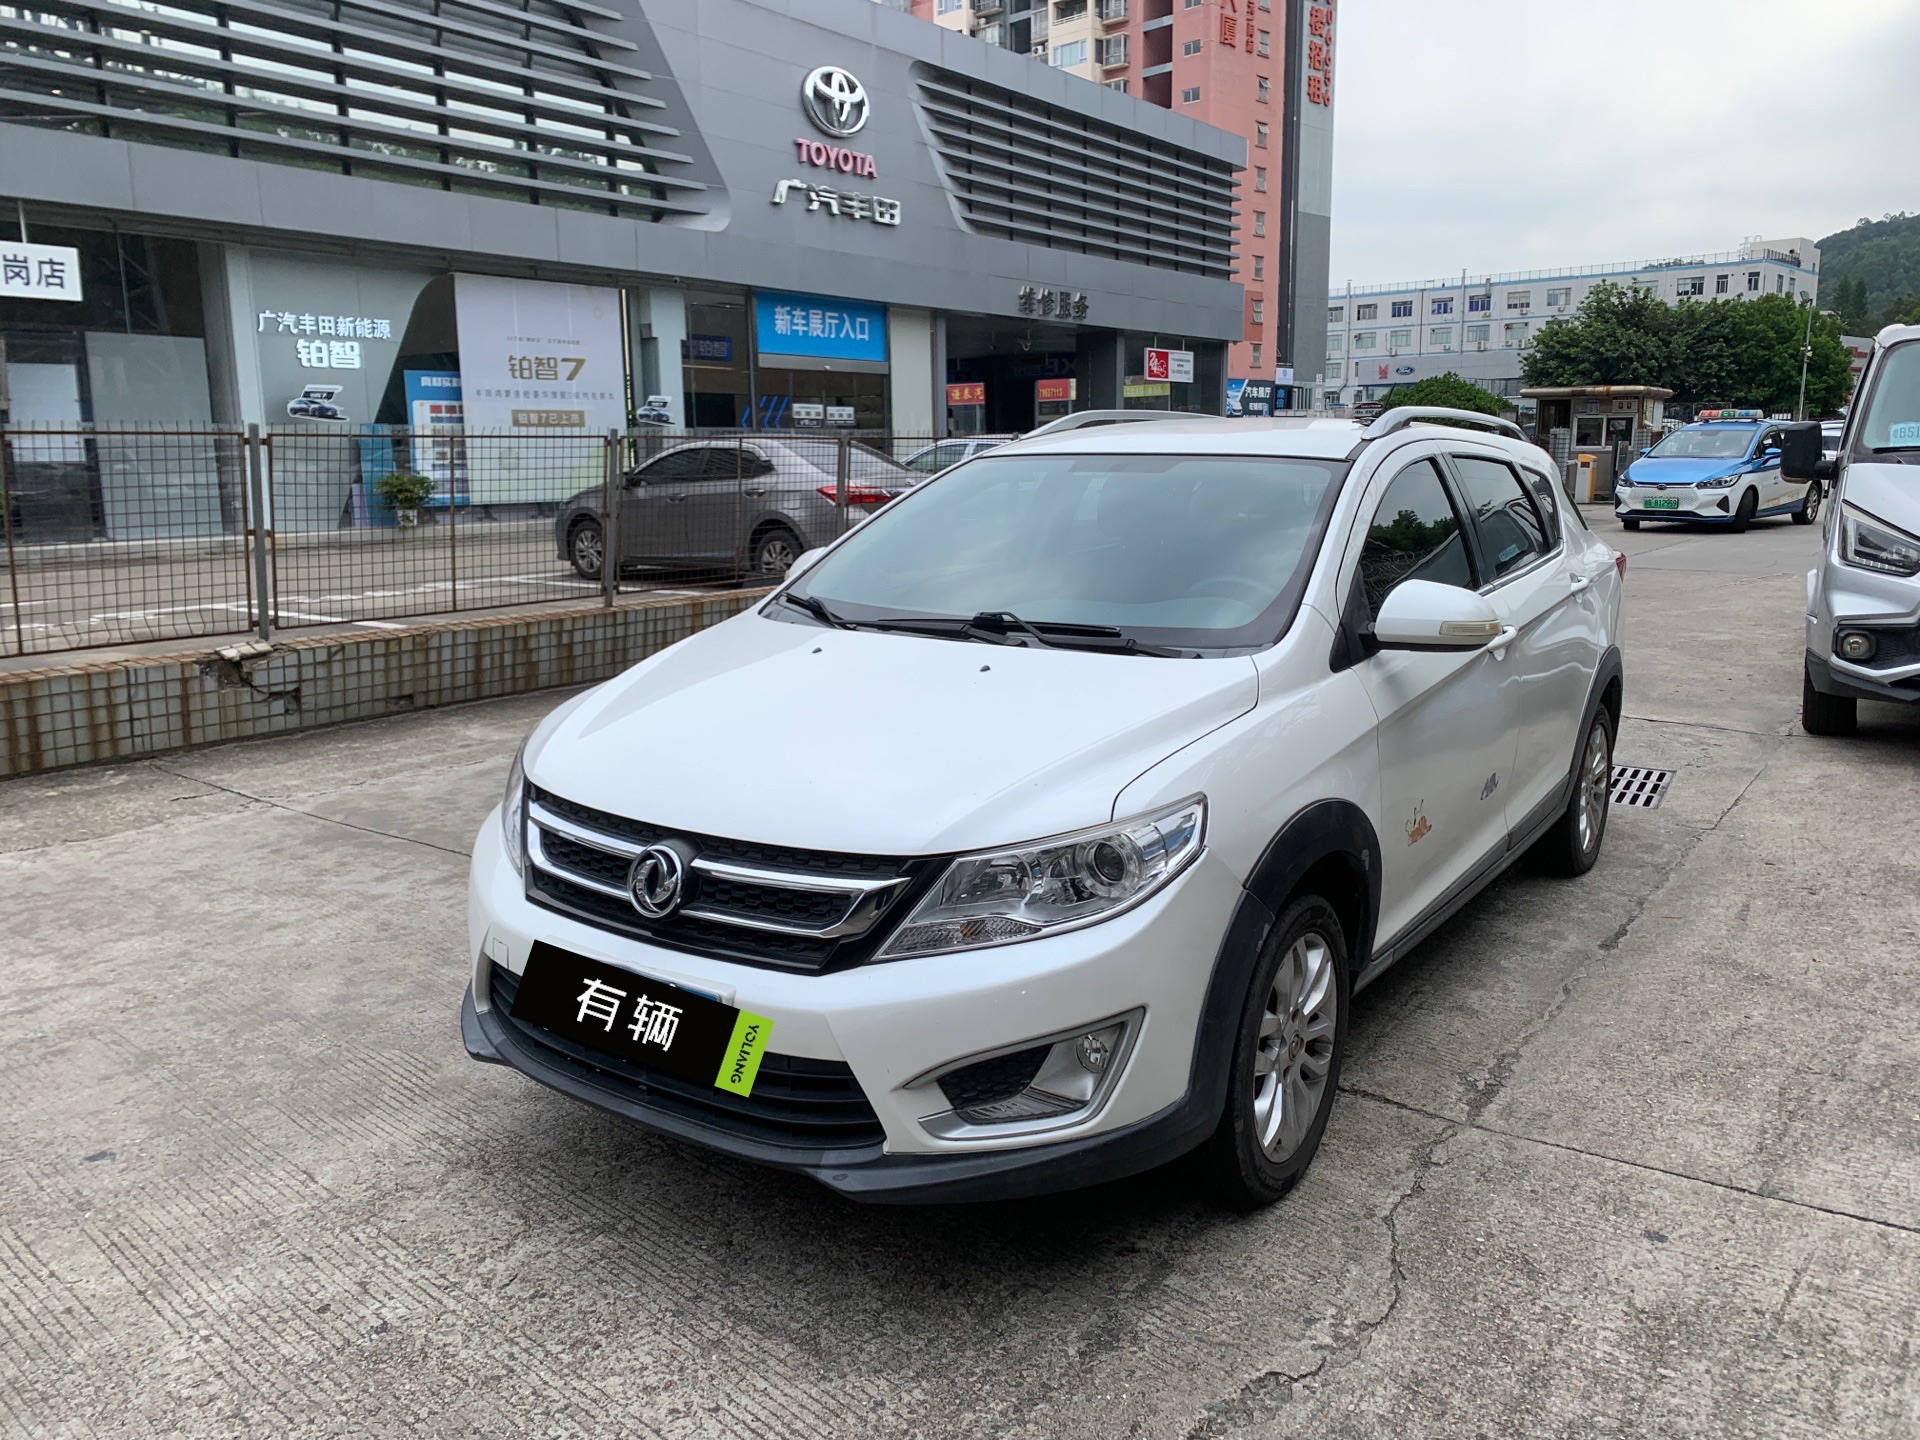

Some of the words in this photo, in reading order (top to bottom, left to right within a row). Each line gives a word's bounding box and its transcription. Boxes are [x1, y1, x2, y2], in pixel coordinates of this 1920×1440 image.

[1308, 0, 1325, 104] 楼招租
[794, 138, 877, 179] TOYOTA
[771, 178, 901, 227] 广汽丰田
[1, 255, 66, 290] 岗店
[1018, 285, 1089, 320] 维修服务
[257, 311, 392, 341] 广汽丰田新能源
[774, 305, 870, 341] 新车展厅入口
[296, 339, 362, 369] 铂智
[508, 355, 587, 381] 铂智7
